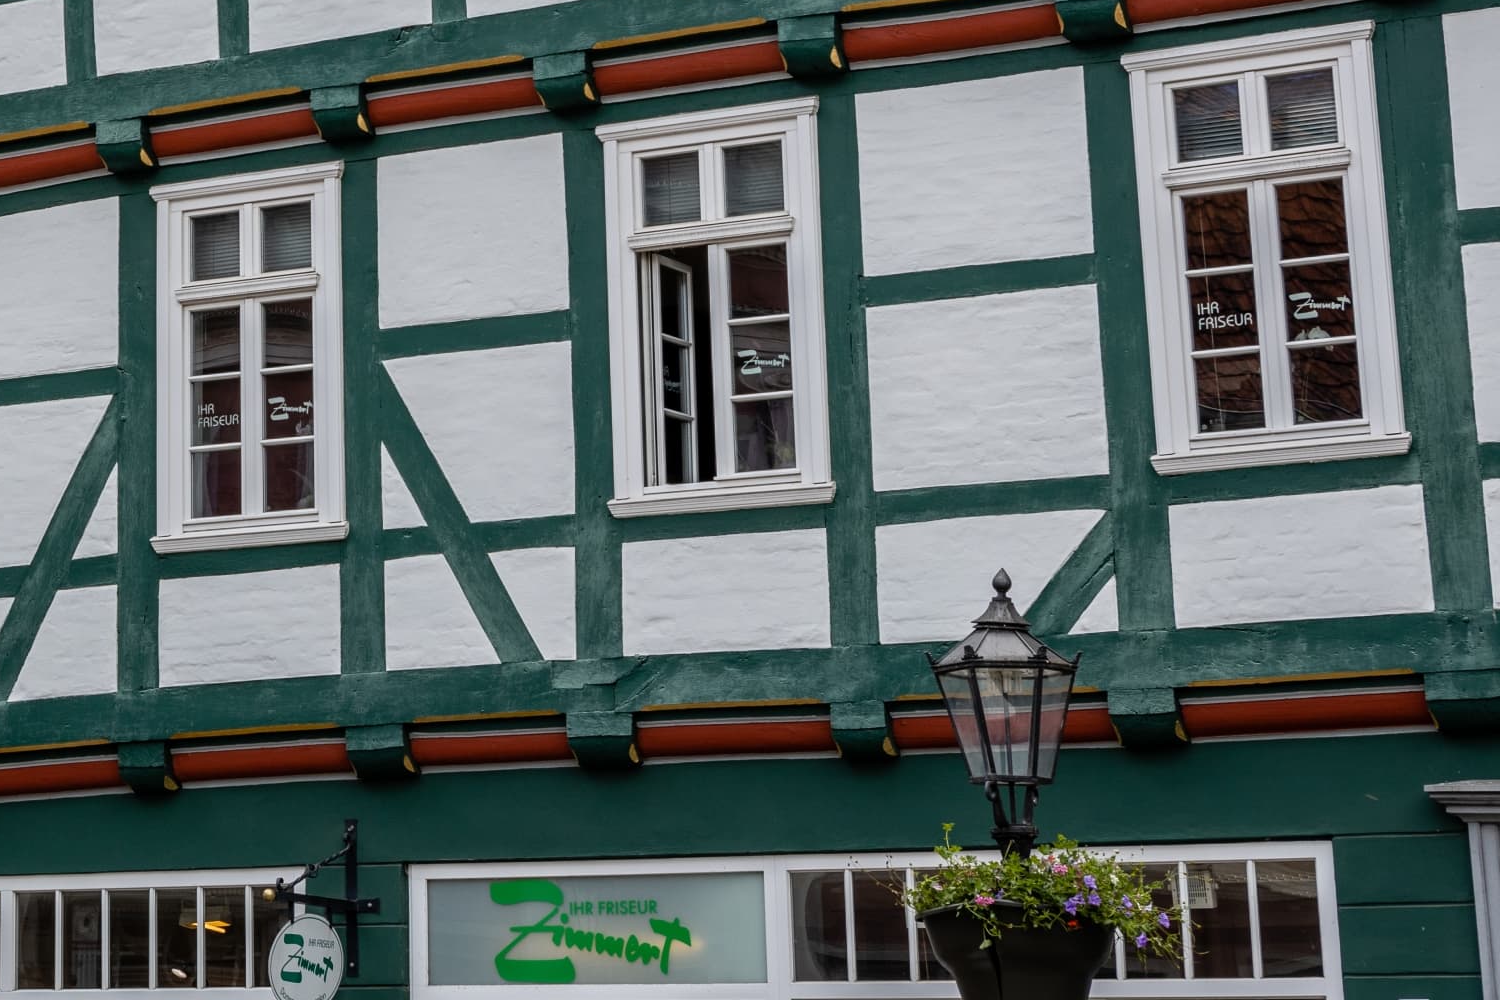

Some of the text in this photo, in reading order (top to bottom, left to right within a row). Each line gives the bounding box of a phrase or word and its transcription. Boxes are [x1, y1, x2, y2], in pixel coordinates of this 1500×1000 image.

[1197, 301, 1220, 316] IHR
[1198, 312, 1253, 330] FRISEUR
[197, 403, 215, 416] IHR
[197, 413, 240, 428] FRISEUR
[569, 899, 659, 916] IHR FRISEUR
